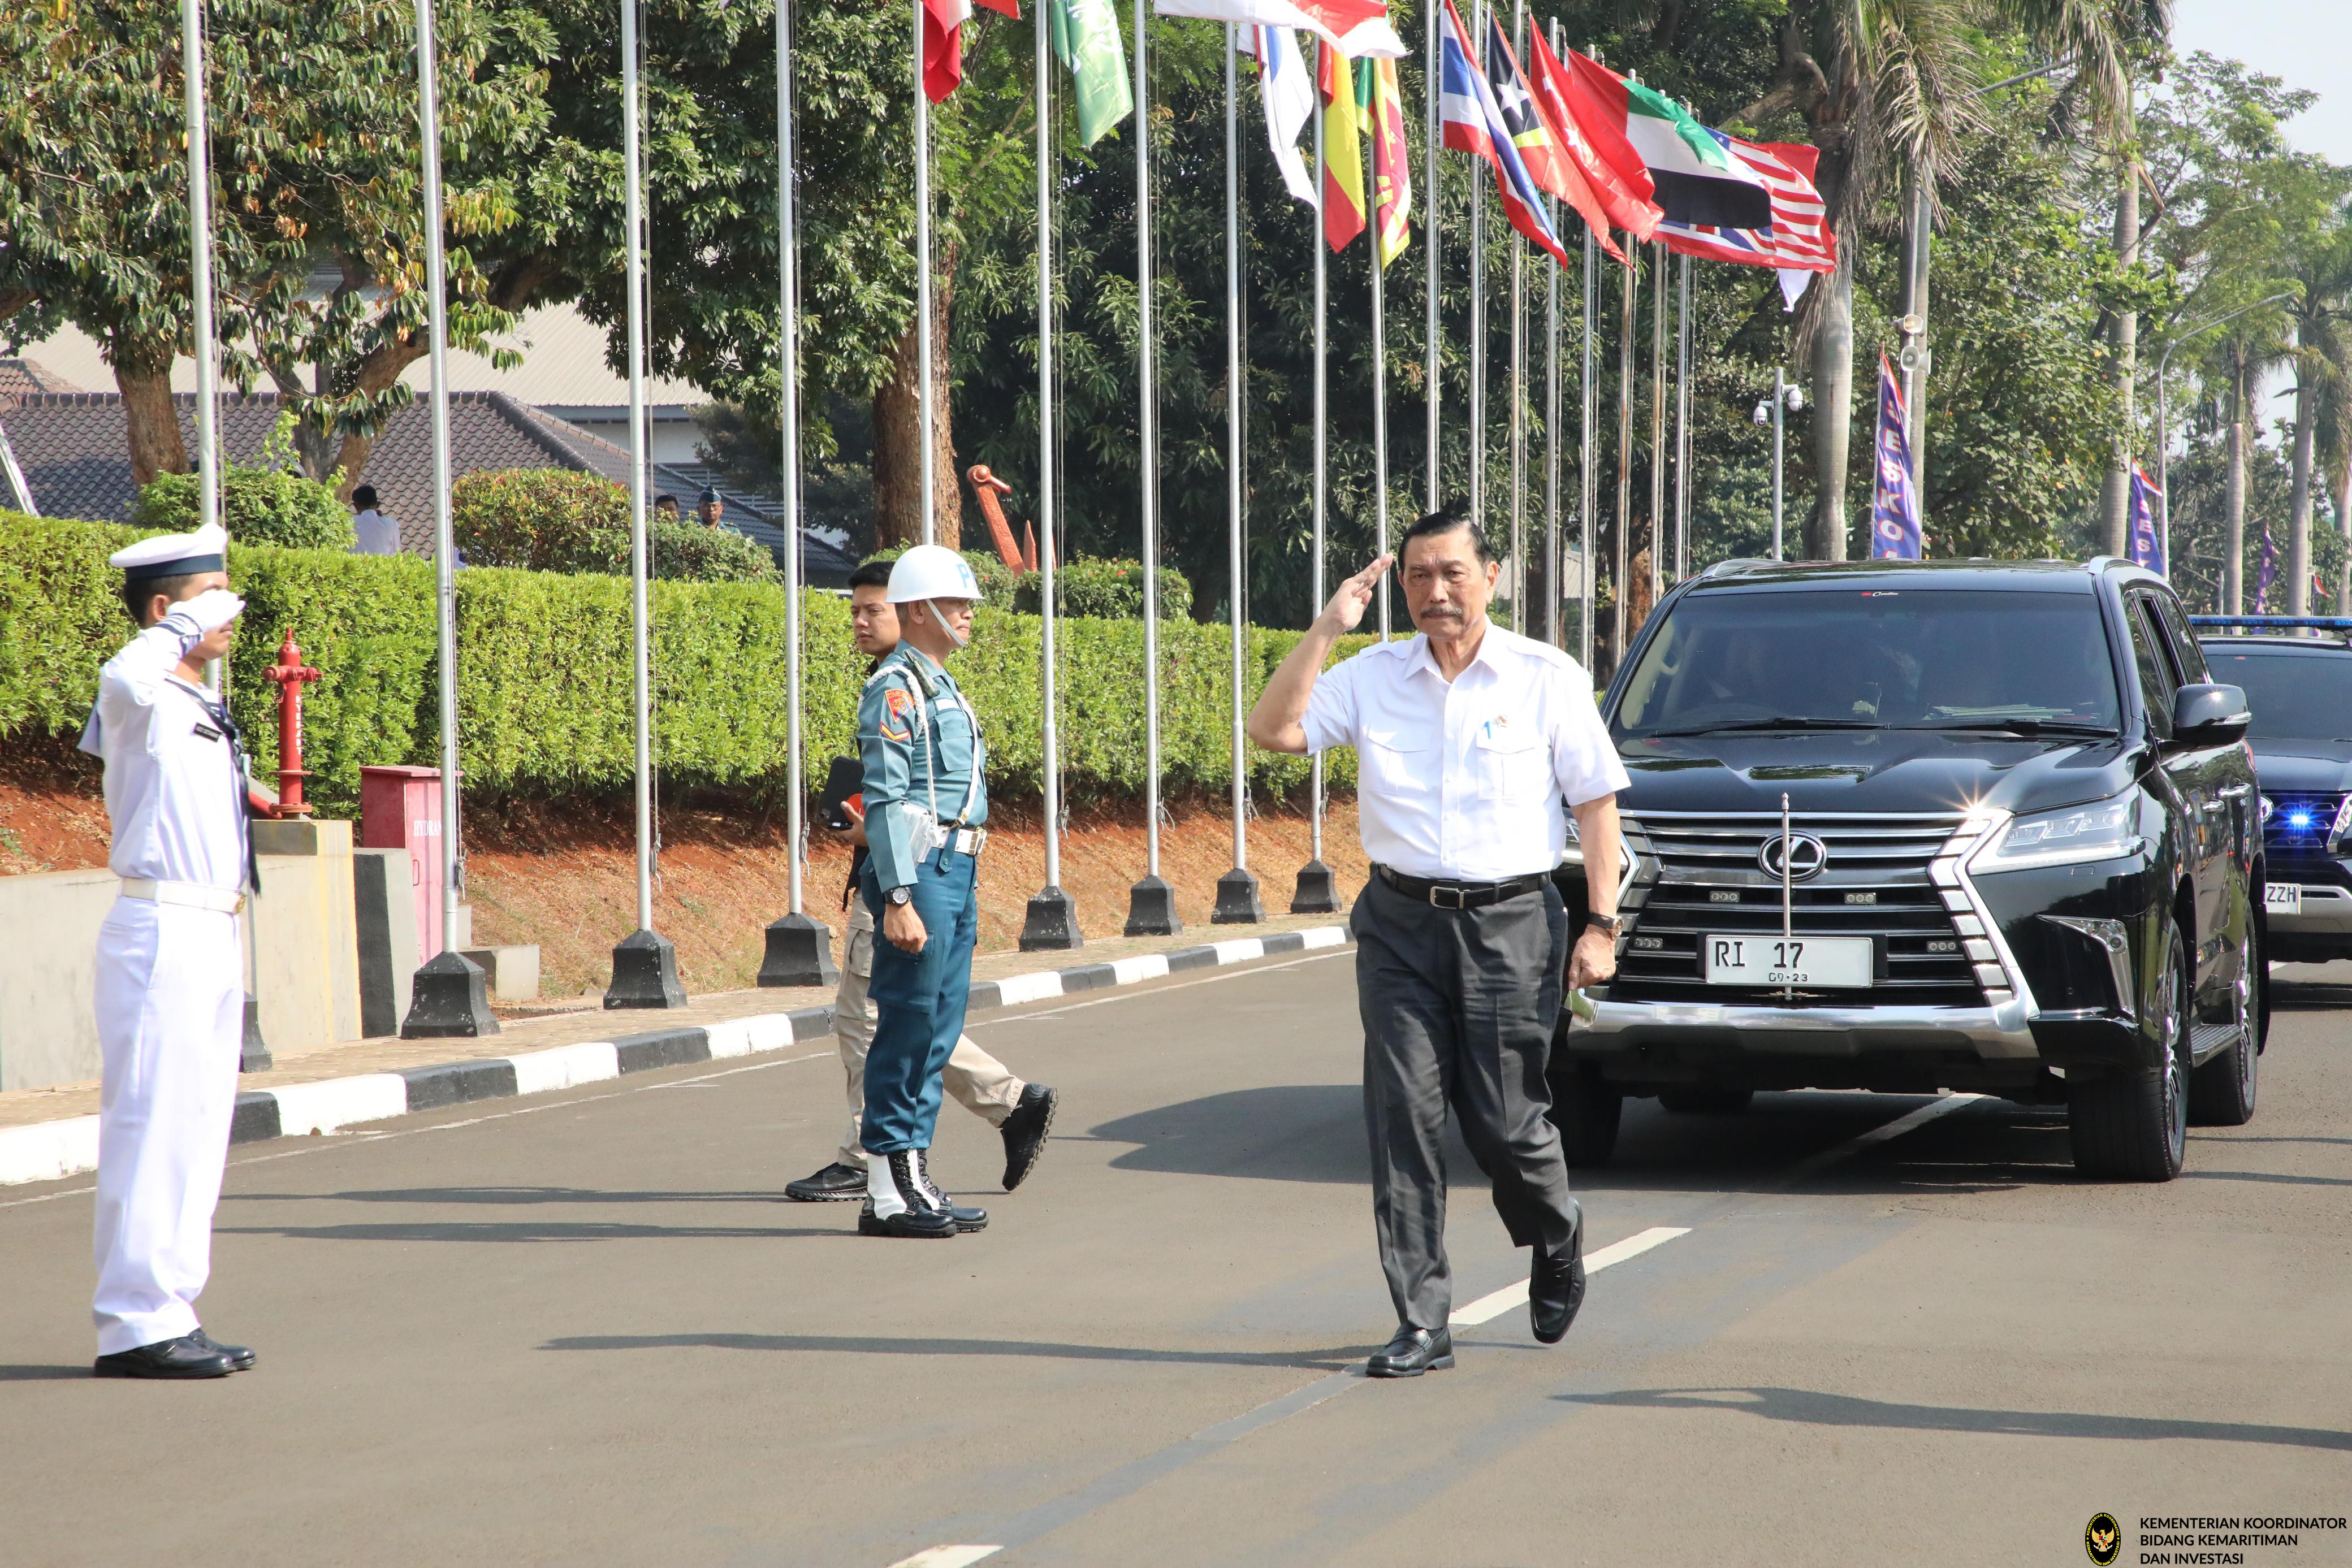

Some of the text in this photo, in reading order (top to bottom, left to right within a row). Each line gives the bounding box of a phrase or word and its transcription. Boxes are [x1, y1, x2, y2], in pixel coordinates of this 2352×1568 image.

[2267, 886, 2297, 903] ZZH
[1715, 941, 1804, 968] RI 17
